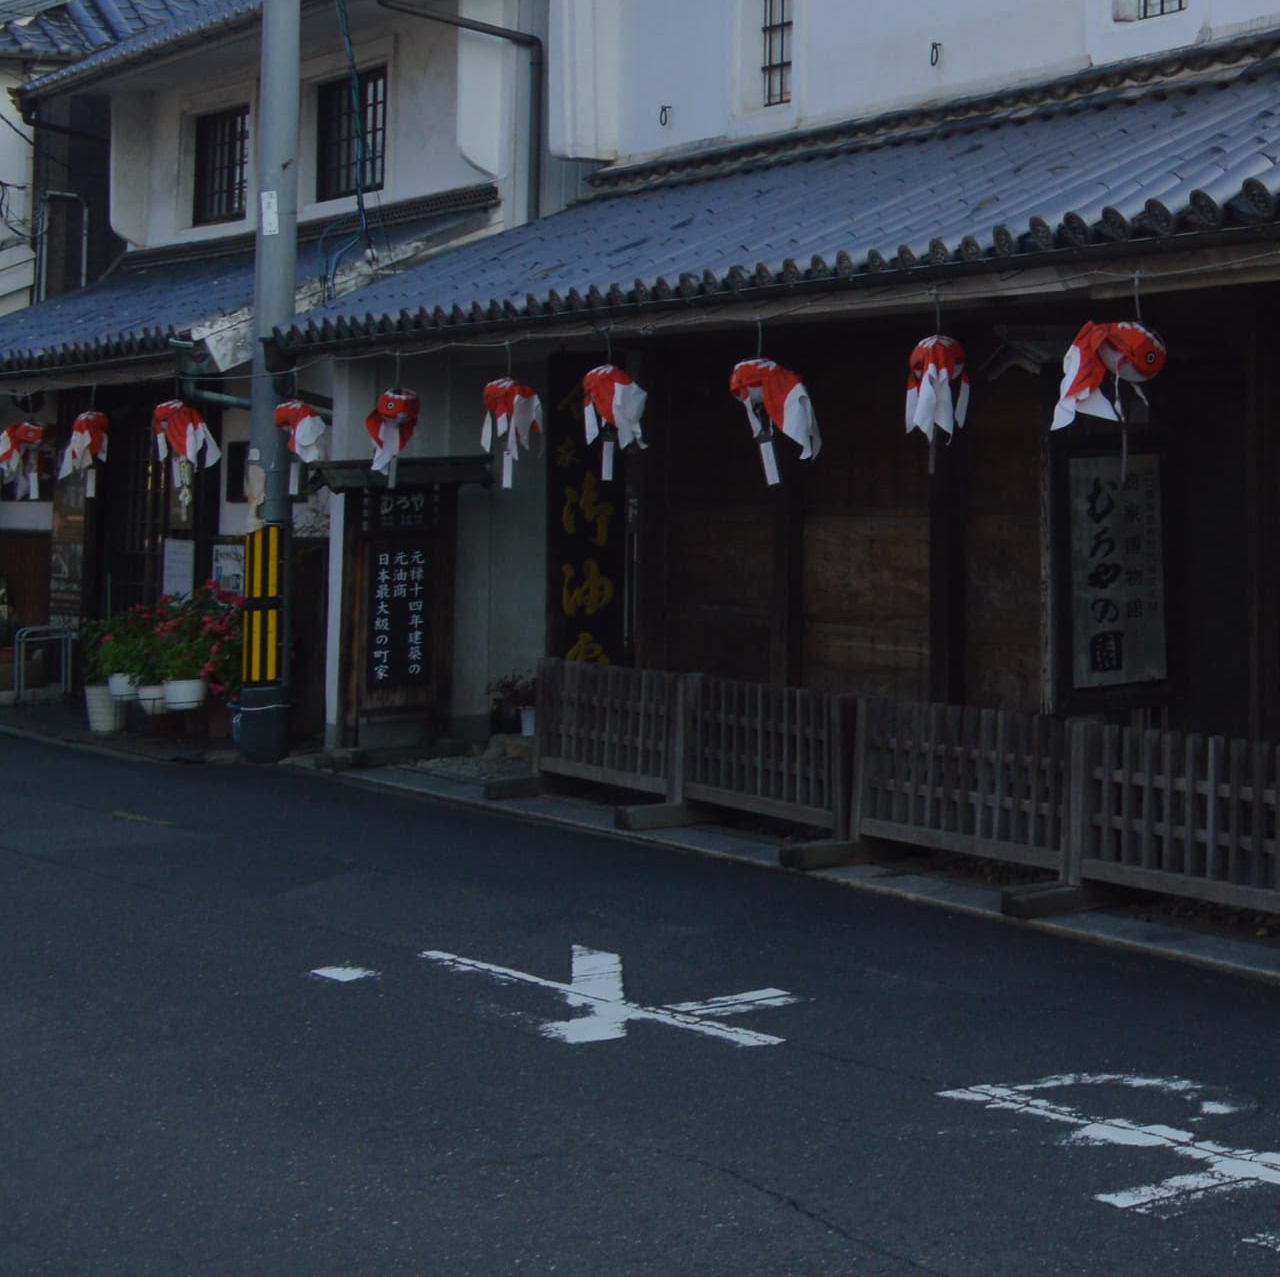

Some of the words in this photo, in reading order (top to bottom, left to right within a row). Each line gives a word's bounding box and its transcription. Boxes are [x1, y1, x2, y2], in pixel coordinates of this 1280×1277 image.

[373, 553, 390, 680] 日本最大級の町家
[393, 552, 408, 598] 元油商
